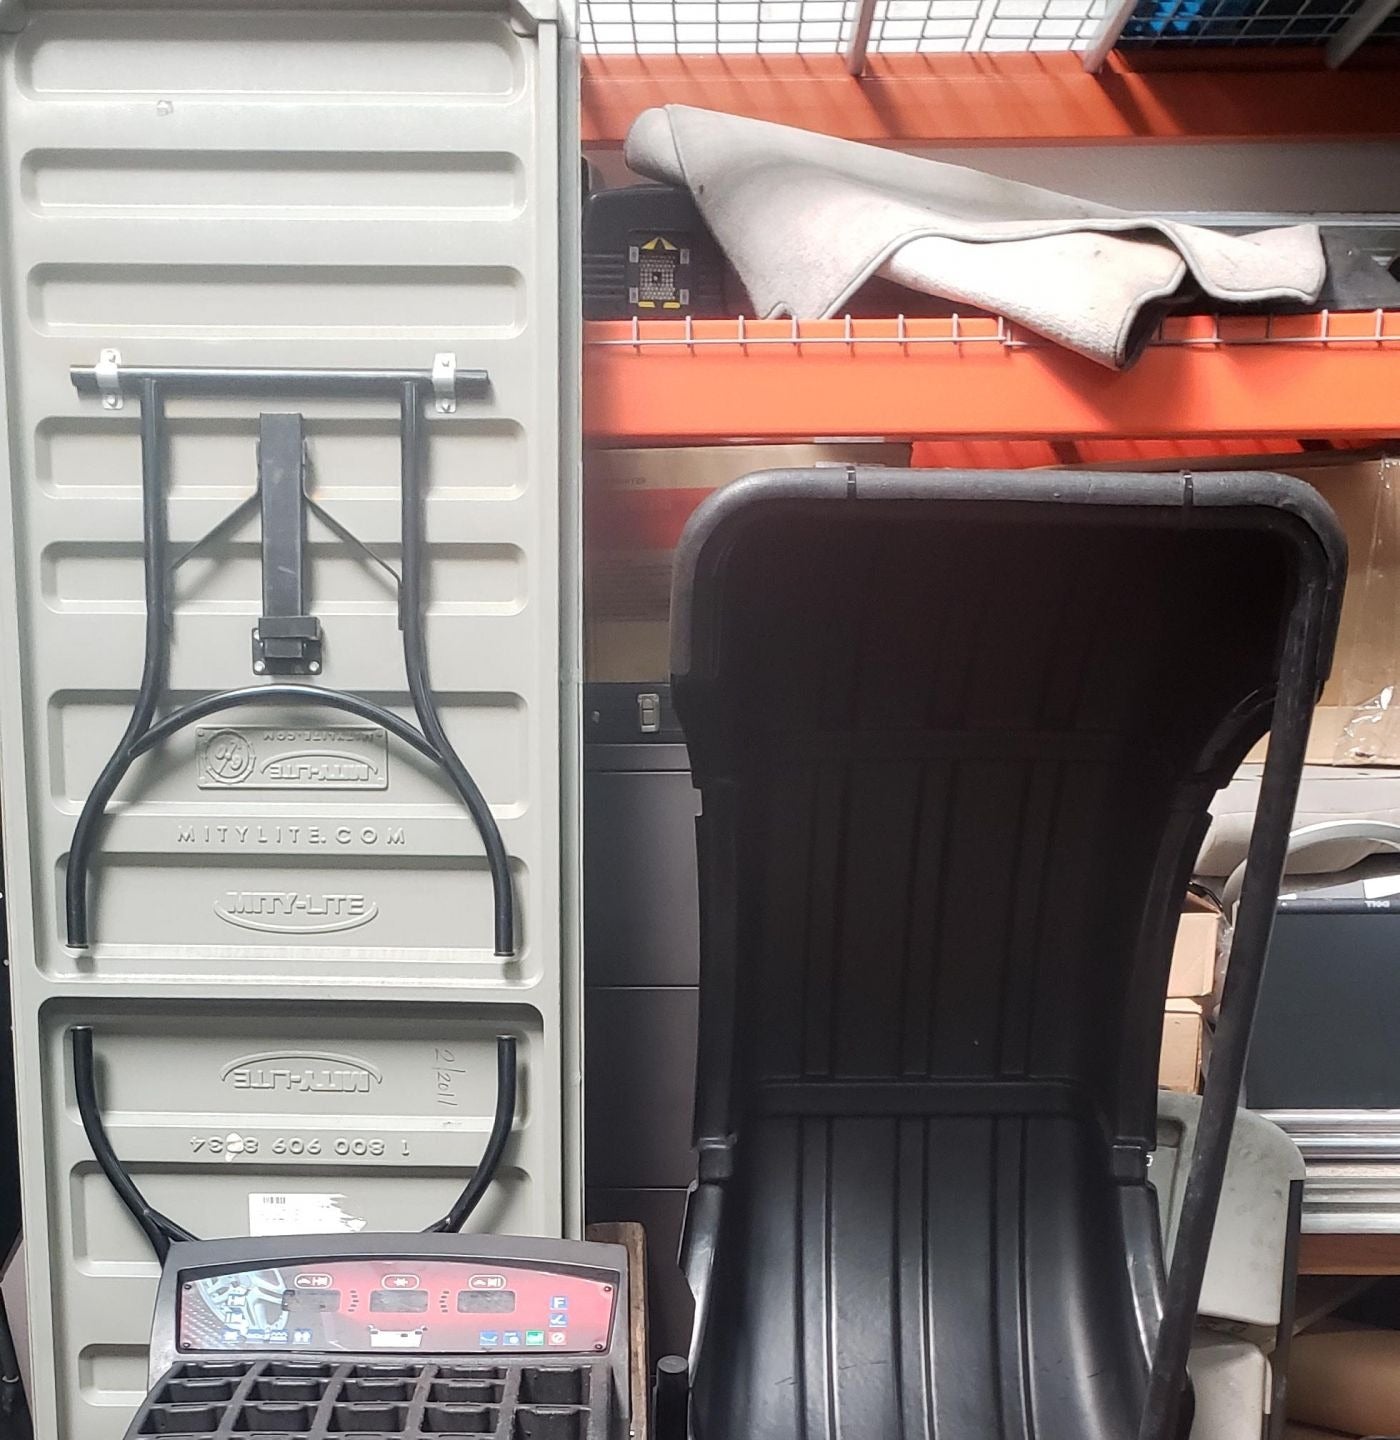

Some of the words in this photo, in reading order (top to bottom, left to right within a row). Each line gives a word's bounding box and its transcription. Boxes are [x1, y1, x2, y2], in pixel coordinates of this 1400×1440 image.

[269, 764, 370, 782] MITY-LITE
[177, 825, 405, 845] MITYLITE.COM
[226, 891, 365, 915] MITY-LITE
[233, 1070, 370, 1093] MITY-LITE
[271, 1137, 322, 1156] 909
[334, 1137, 385, 1157] 800
[401, 1138, 411, 1157] 1
[554, 1296, 565, 1308] F
